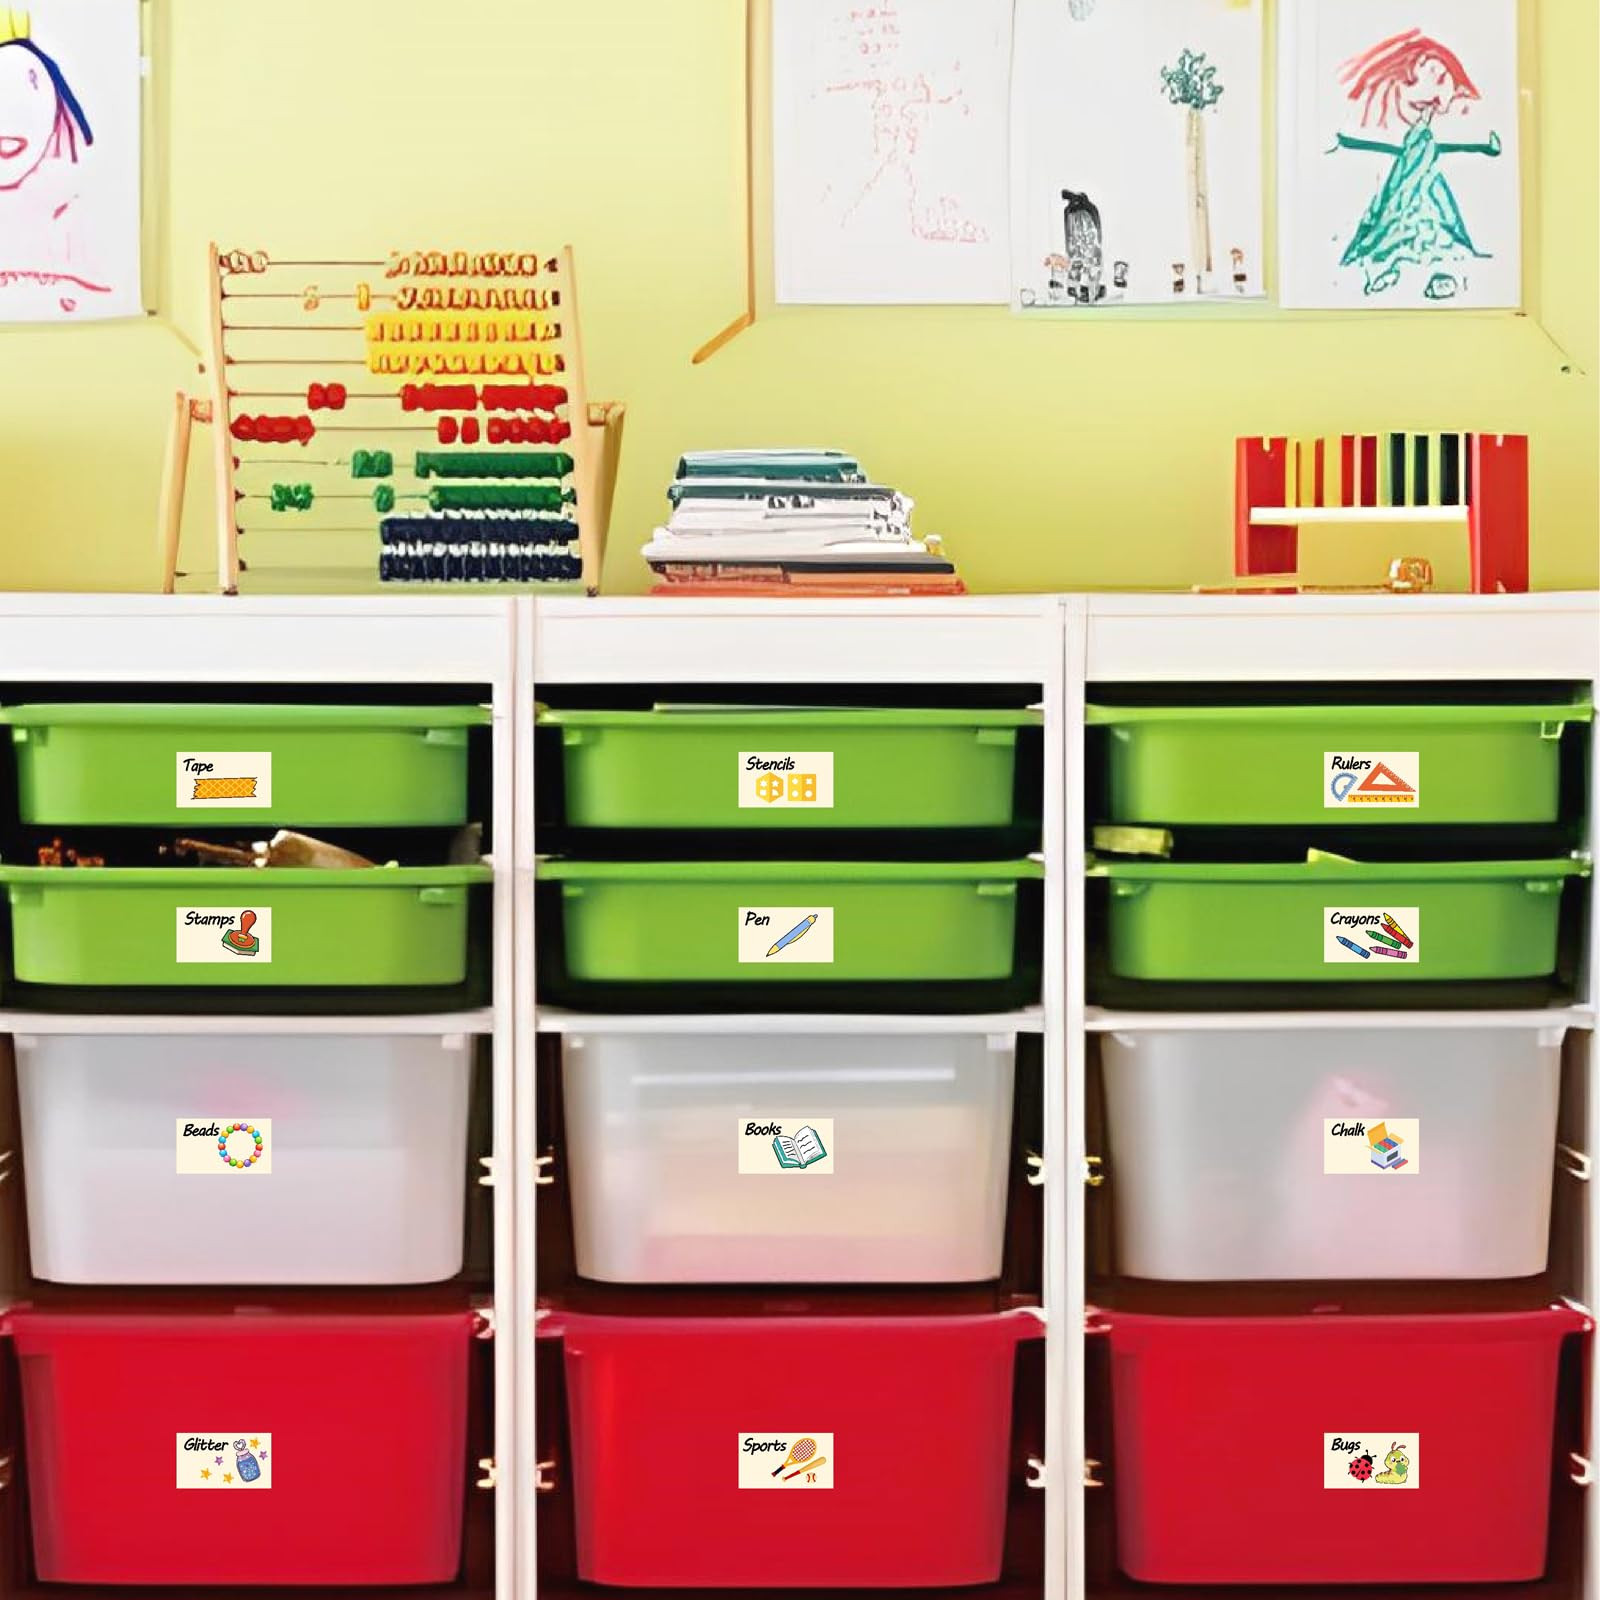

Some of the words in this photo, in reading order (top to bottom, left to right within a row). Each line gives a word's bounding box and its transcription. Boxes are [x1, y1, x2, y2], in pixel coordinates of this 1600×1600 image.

[183, 758, 214, 775] Tape
[745, 756, 796, 771] Stencils
[1331, 756, 1372, 770] Rulers
[184, 910, 235, 929] Stamps
[744, 910, 770, 926] Pen
[1330, 911, 1381, 929] Crayons
[182, 1122, 220, 1137] Beads
[744, 1121, 782, 1136] Books
[1331, 1122, 1366, 1137] Chalk
[183, 1437, 229, 1452] Glitter
[742, 1437, 788, 1456] Sports
[1331, 1437, 1361, 1455] Bugs
